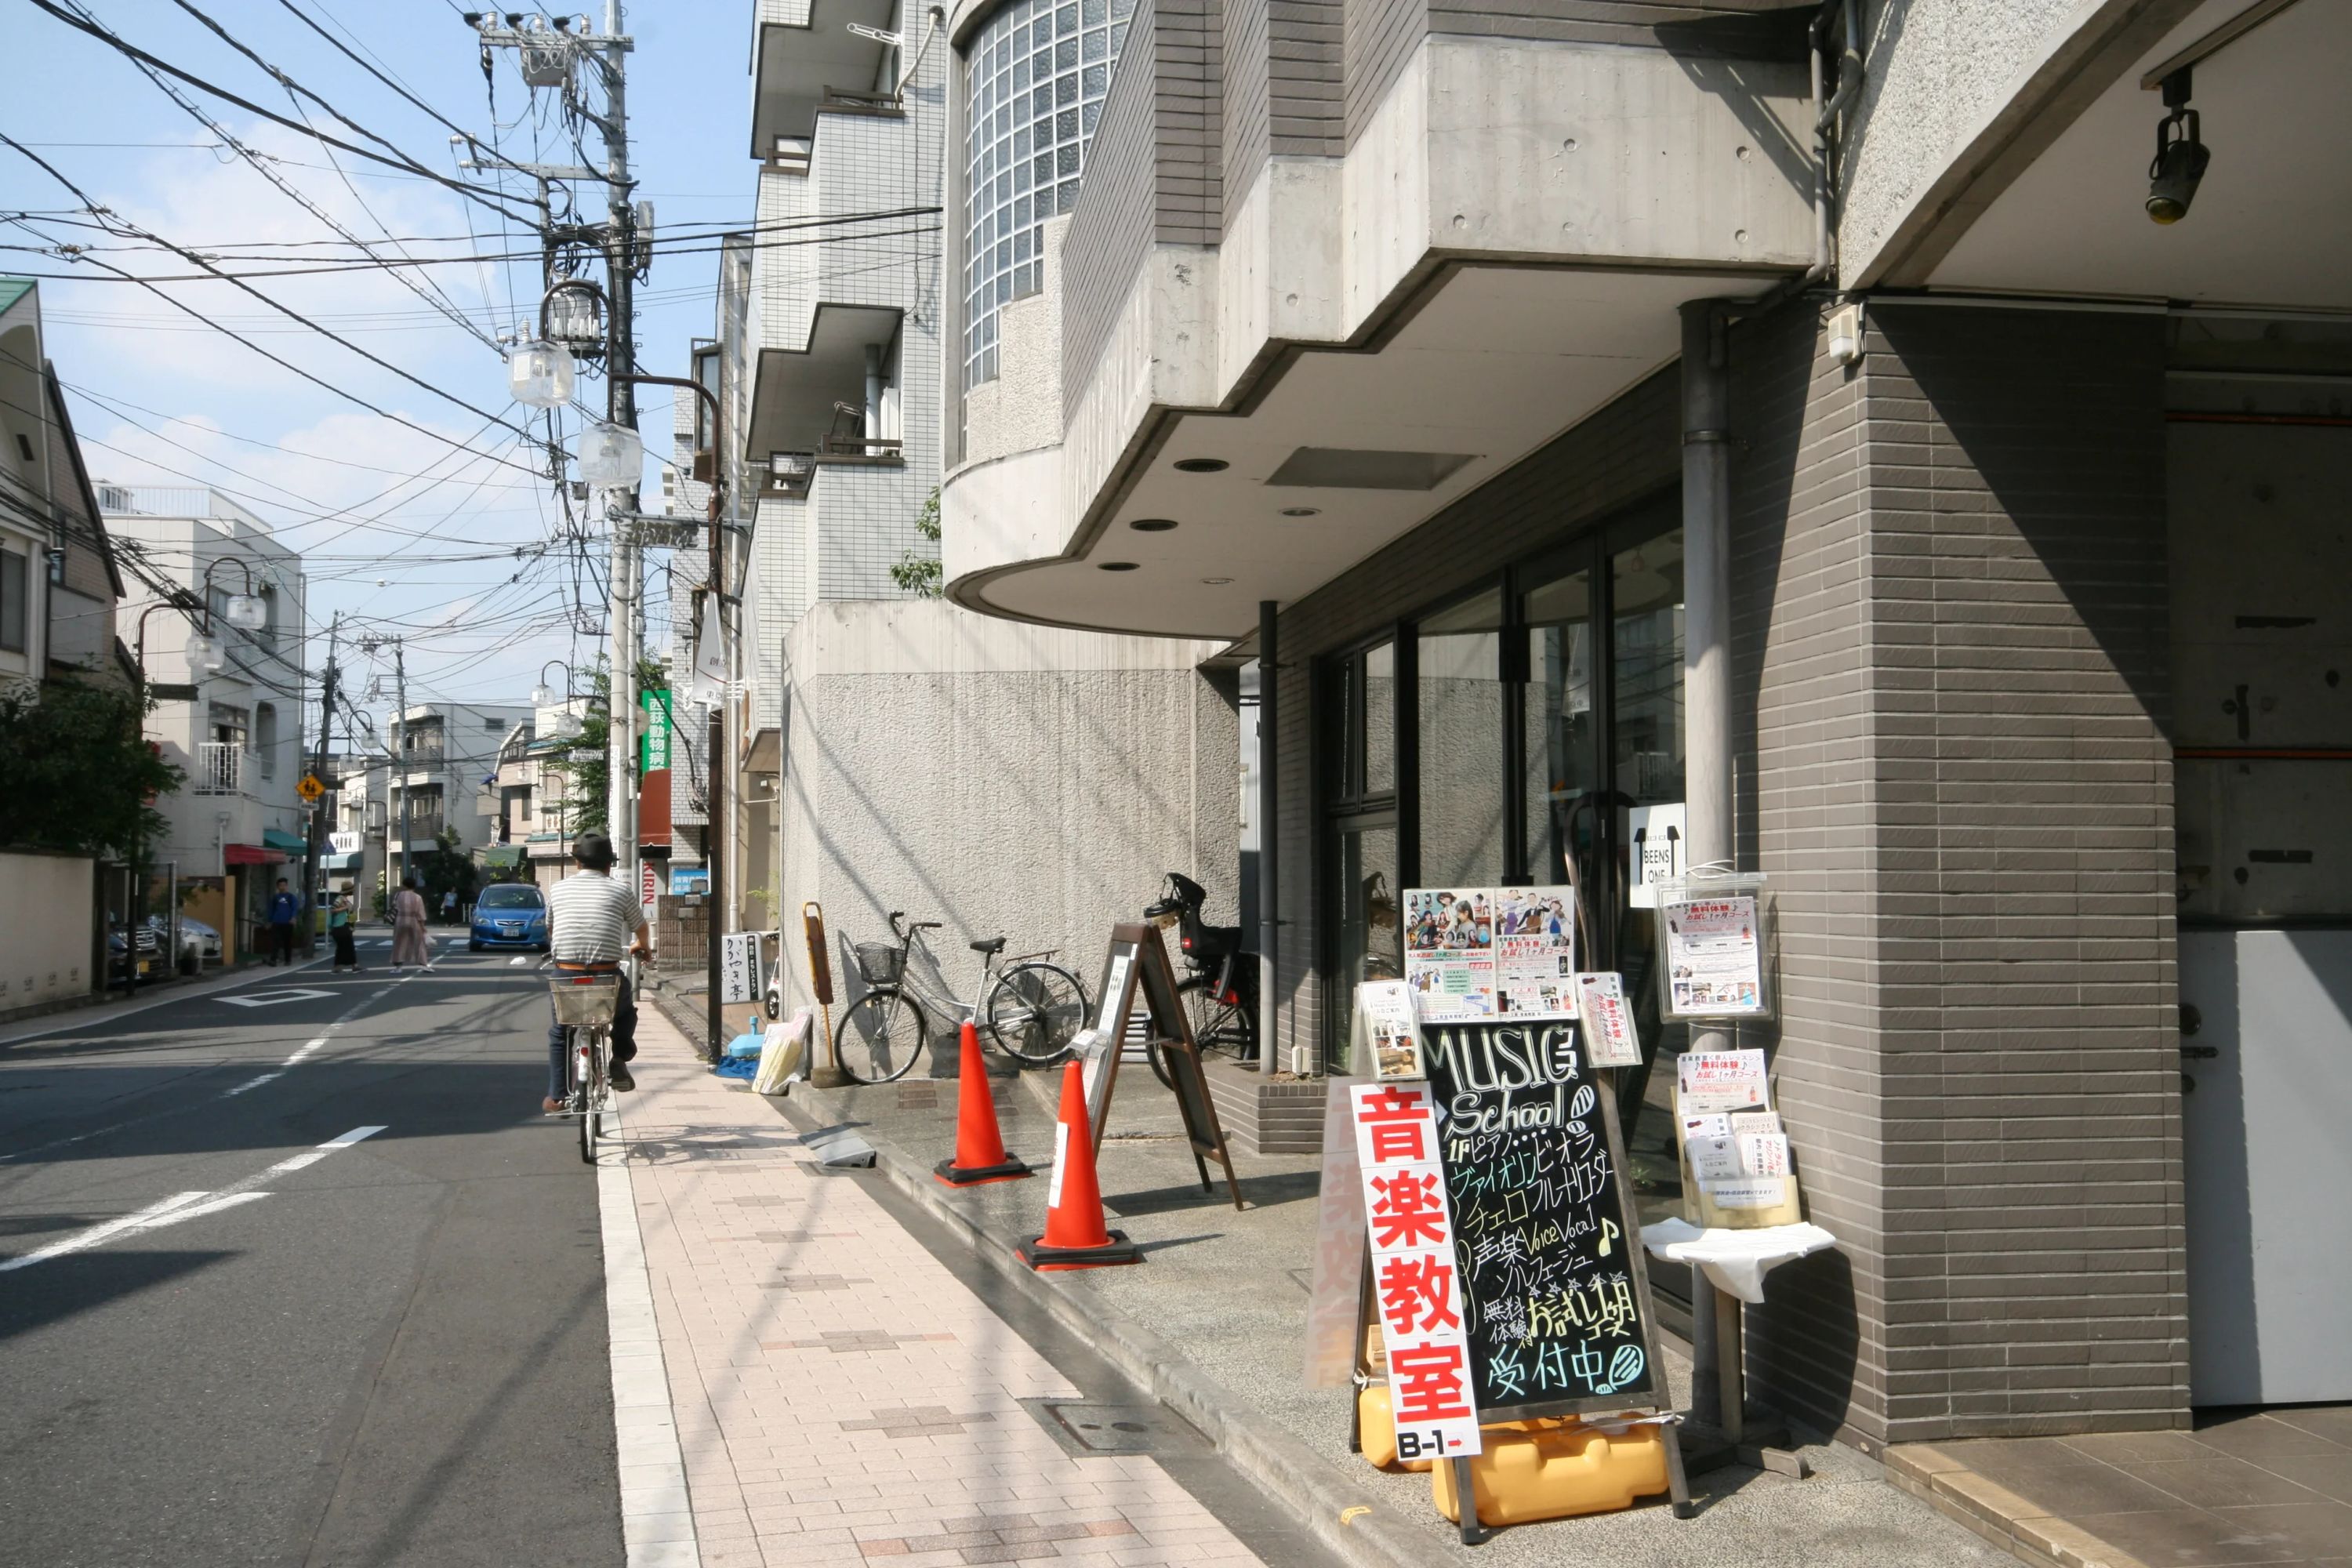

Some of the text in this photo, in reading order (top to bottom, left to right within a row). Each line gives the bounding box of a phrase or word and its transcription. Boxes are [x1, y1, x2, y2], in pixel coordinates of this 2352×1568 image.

[1644, 849, 1669, 863] BEENS
[643, 862, 655, 904] KIRIN
[1443, 1083, 1565, 1135] School
[1447, 1133, 1512, 1163] 1F ピアノ
[1534, 1131, 1595, 1172] ビオラ
[1451, 1152, 1536, 1200] ヴァイオリン
[1465, 1189, 1528, 1238] チェロ
[1358, 1086, 1471, 1424] 音楽教室
[1473, 1203, 1597, 1282] 声楽 Voice Vocal
[1497, 1243, 1593, 1298] ソルフェージュ
[1483, 1296, 1524, 1323] 無料
[1488, 1340, 1603, 1399] 受付中
[1398, 1430, 1445, 1458] B-1
